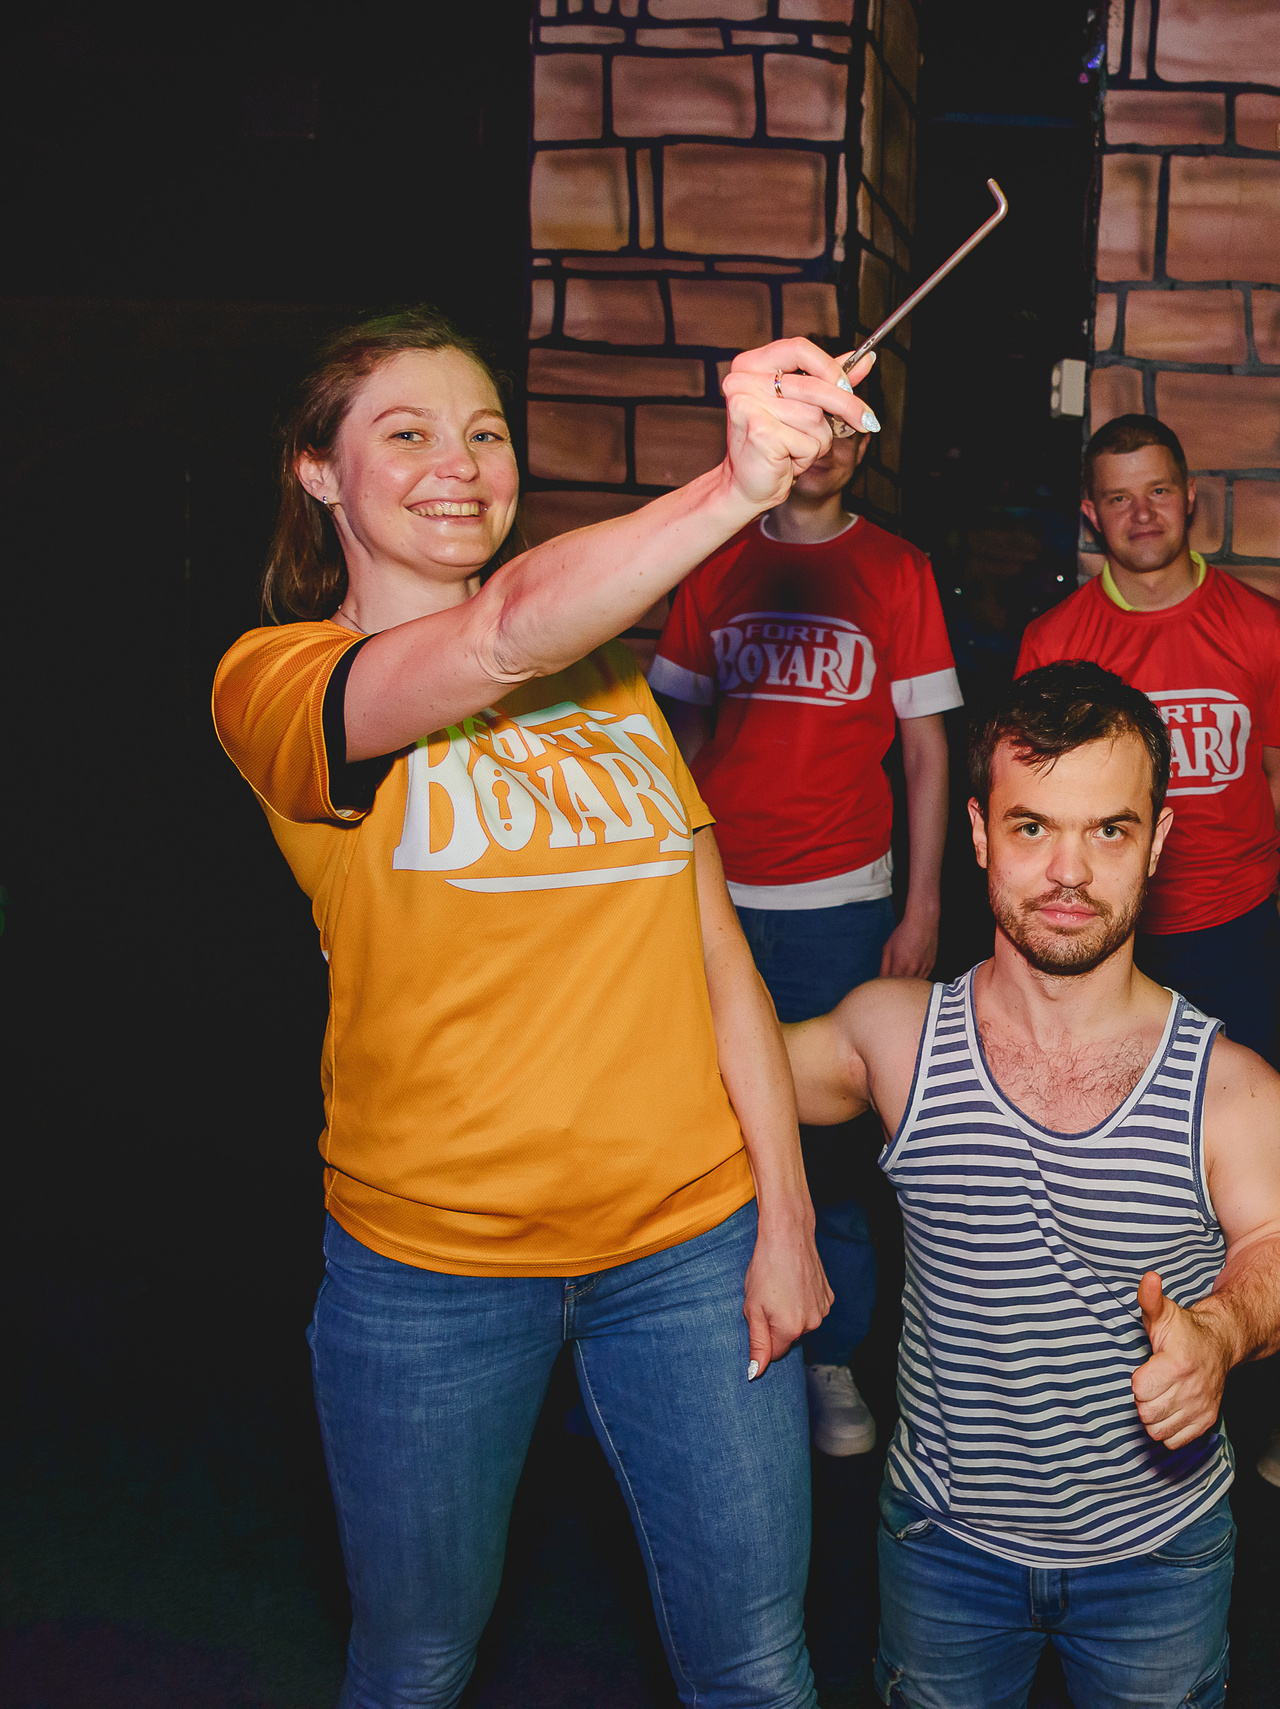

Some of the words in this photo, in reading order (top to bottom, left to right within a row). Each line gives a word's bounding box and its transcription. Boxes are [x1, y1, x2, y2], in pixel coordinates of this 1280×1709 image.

[710, 626, 877, 701] BOYARD
[745, 624, 830, 644] FORT
[1160, 704, 1208, 725] RT
[1169, 703, 1252, 783] ARD
[392, 713, 695, 871] BOYARD
